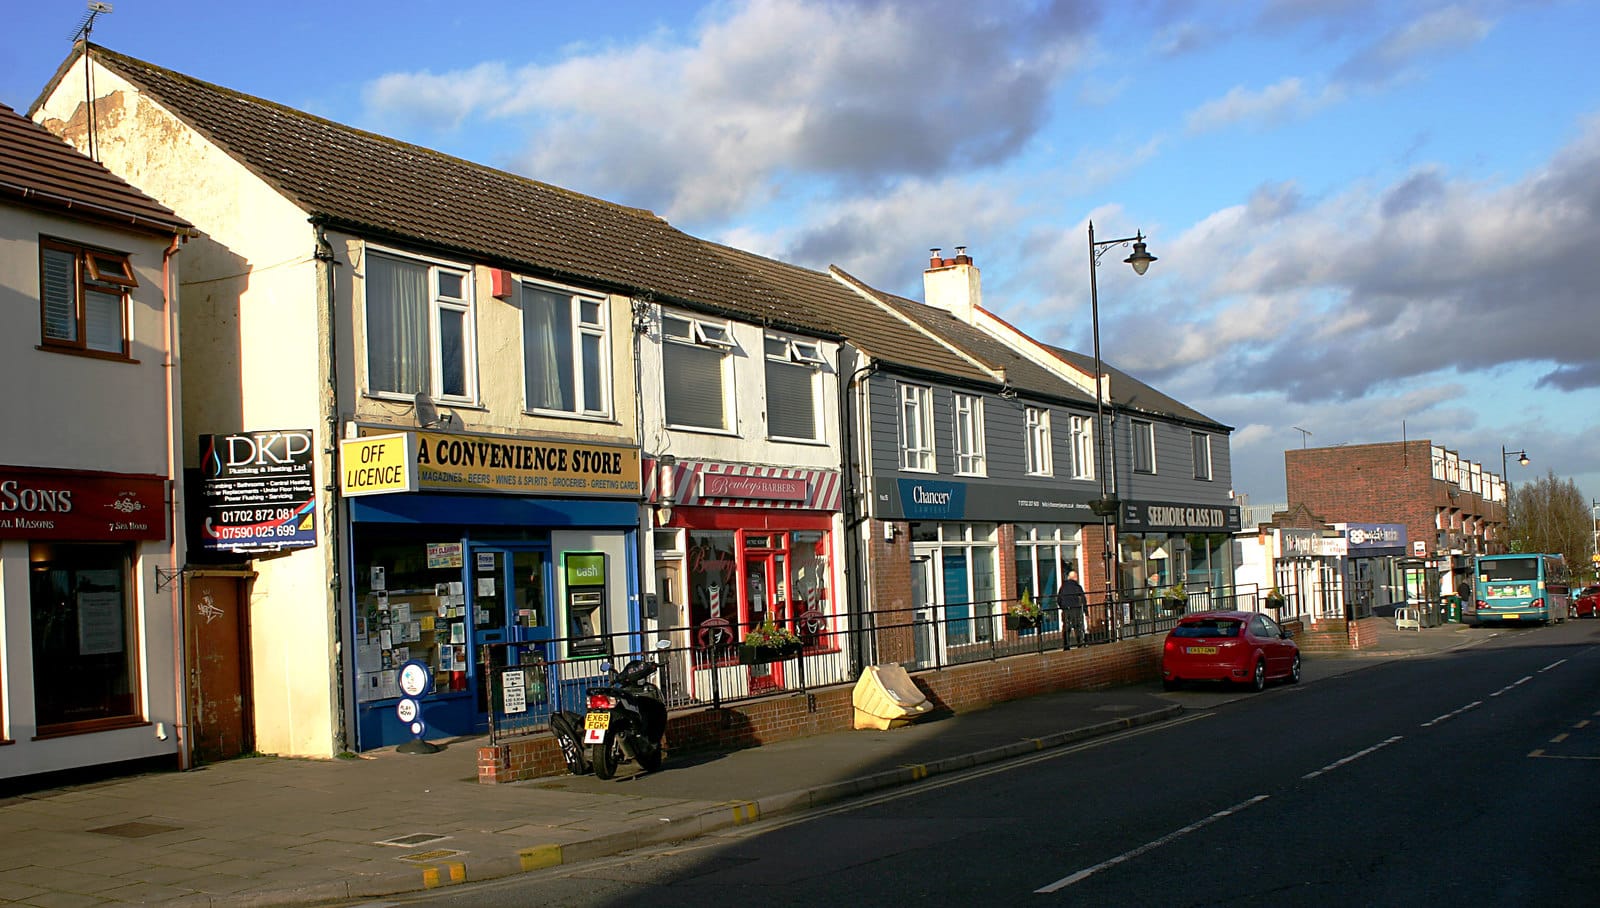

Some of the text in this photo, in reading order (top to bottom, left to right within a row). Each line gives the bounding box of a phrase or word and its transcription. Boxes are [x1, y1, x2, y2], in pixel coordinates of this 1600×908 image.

[226, 433, 311, 466] DKP
[361, 444, 386, 464] OFF
[436, 440, 568, 472] CONVENIENCE
[572, 449, 622, 475] STORE
[229, 467, 259, 475] Plumbing
[347, 465, 402, 488] LICENCE
[422, 471, 638, 490] MAGAZINES BEERS WINES & SPIRITS GROCERIES GREETING CARDS
[1, 480, 73, 513] SONS
[762, 482, 796, 493] BARBERS
[913, 485, 953, 507] Chancery
[15, 518, 55, 529] MASONS
[222, 508, 294, 522] 01702 872 081
[1147, 506, 1224, 527] SEEMORE GLASS LTD
[222, 524, 296, 539] 07590 025 699
[576, 564, 598, 577] cash
[590, 730, 600, 739] L
